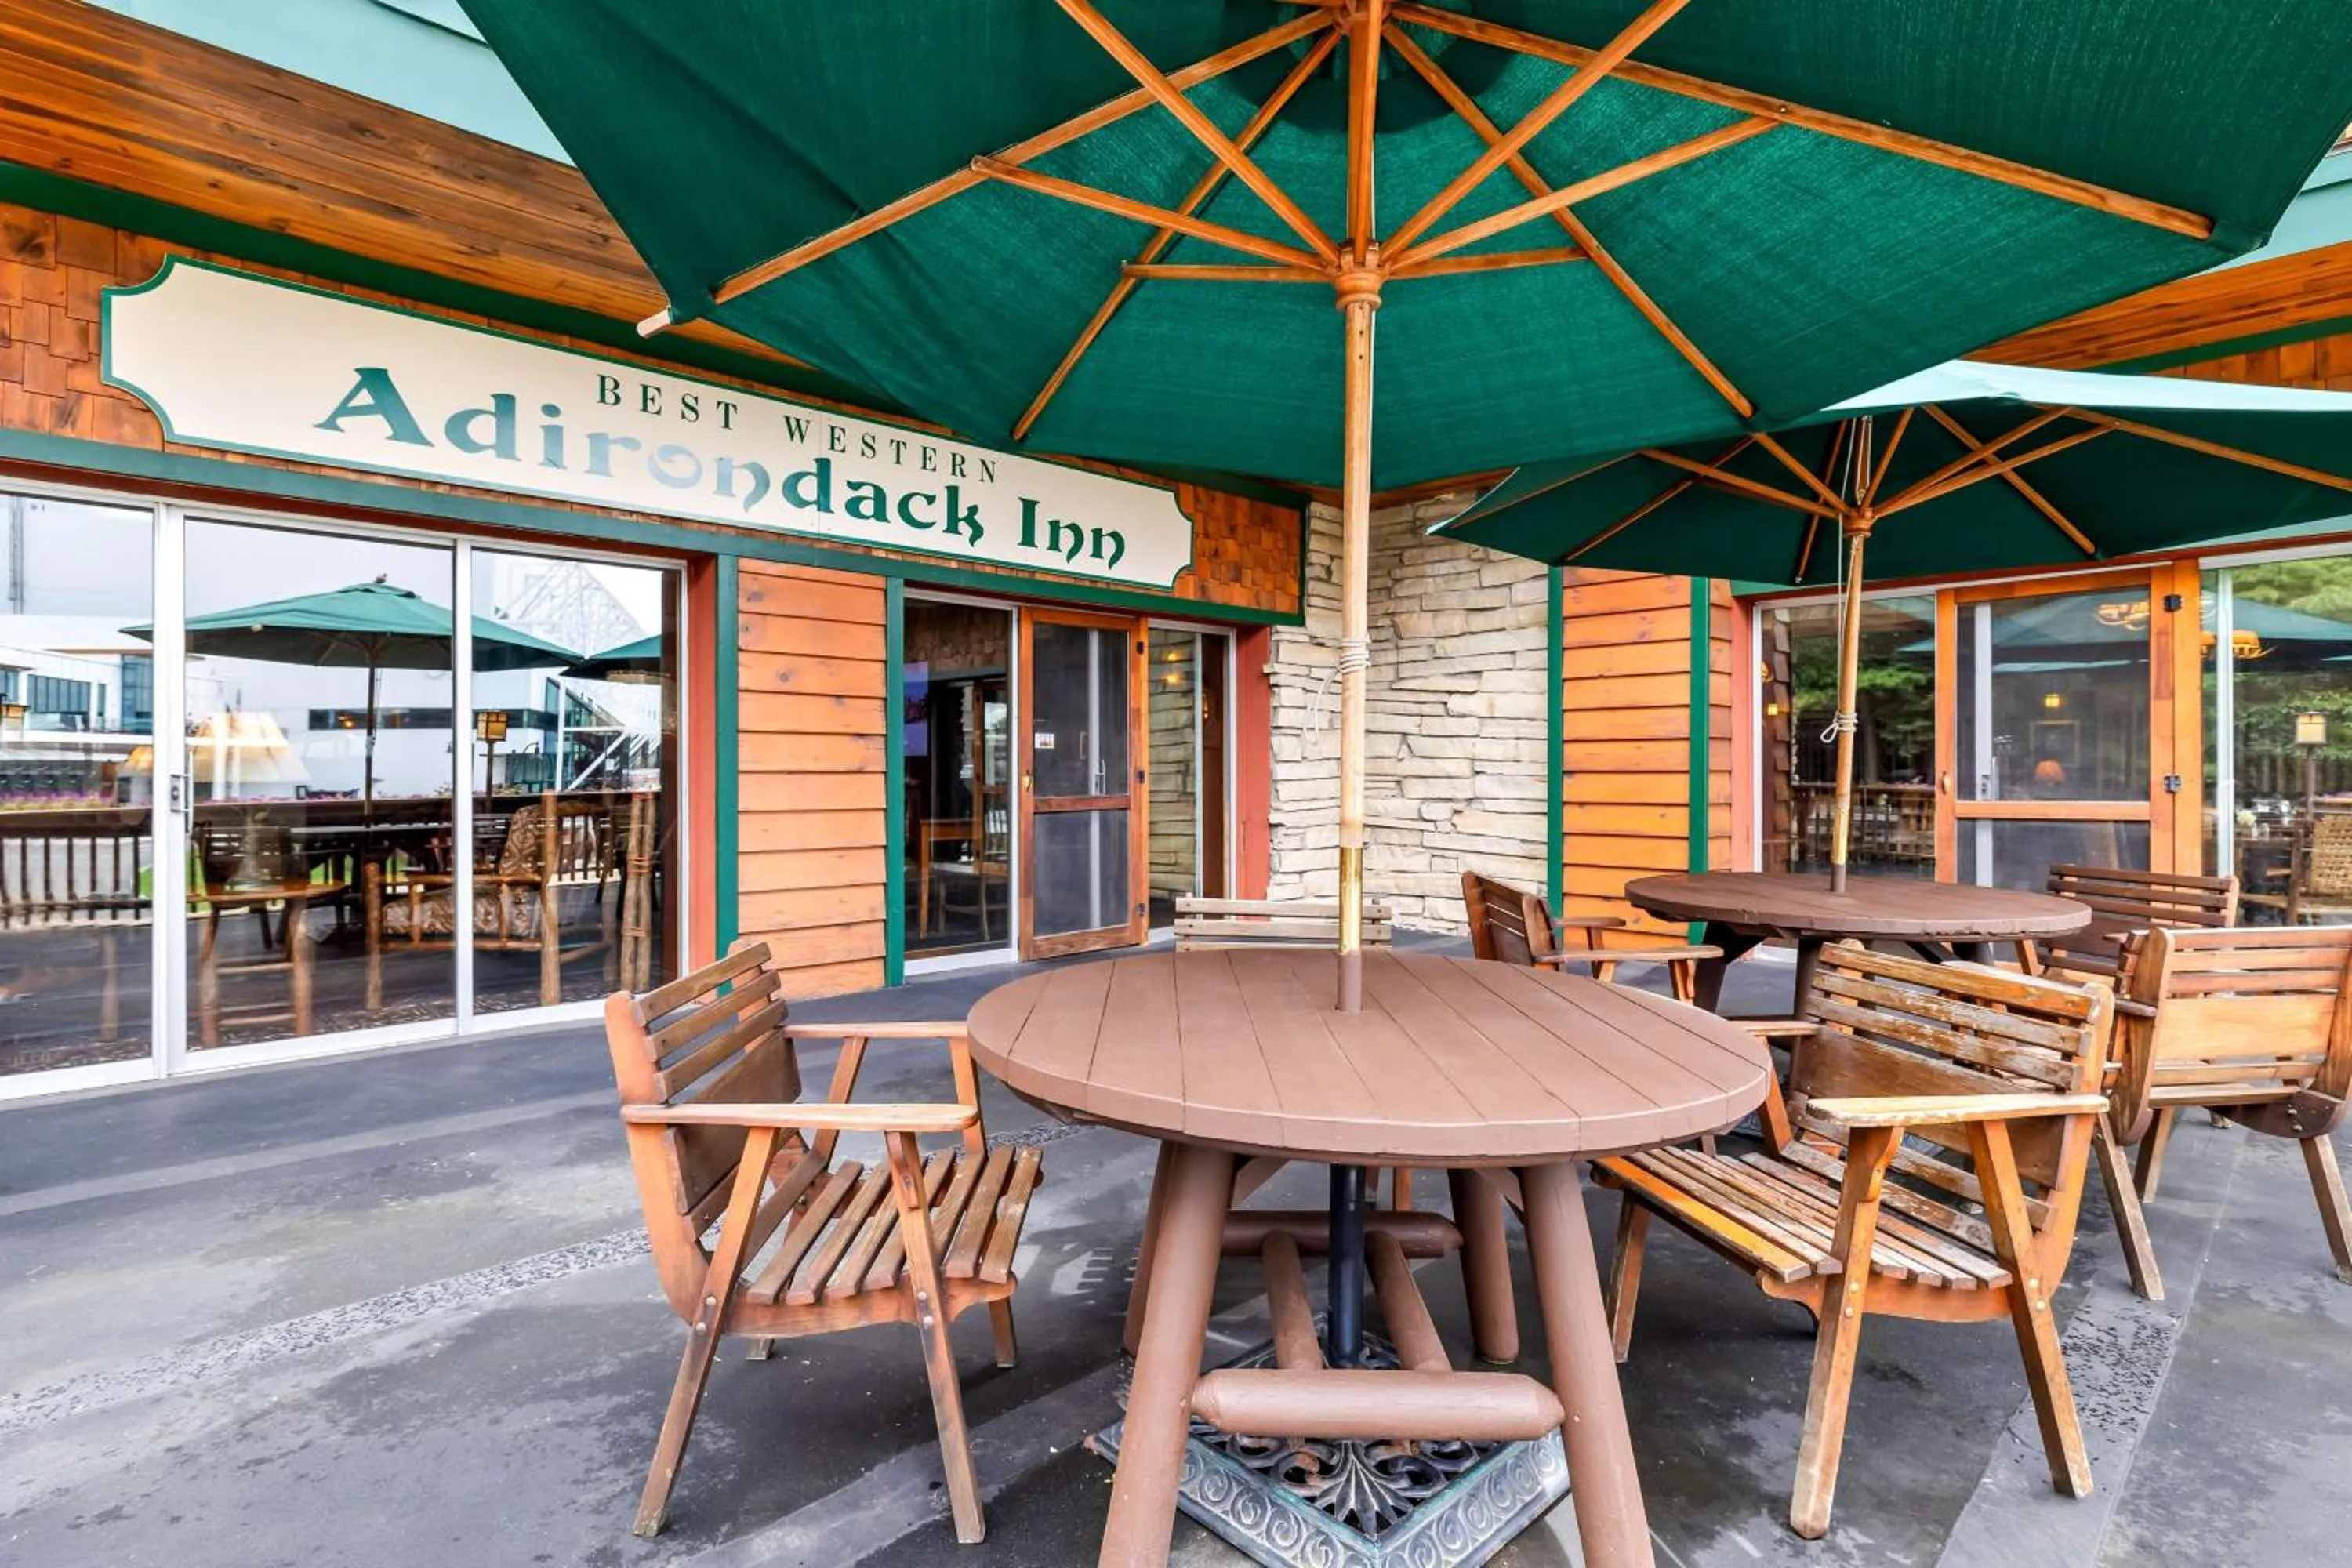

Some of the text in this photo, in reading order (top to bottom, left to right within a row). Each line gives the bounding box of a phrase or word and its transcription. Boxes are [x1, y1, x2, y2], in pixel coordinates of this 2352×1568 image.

[313, 366, 1127, 571] Adirondack Inn
[597, 373, 998, 484] BEST WESTERN
